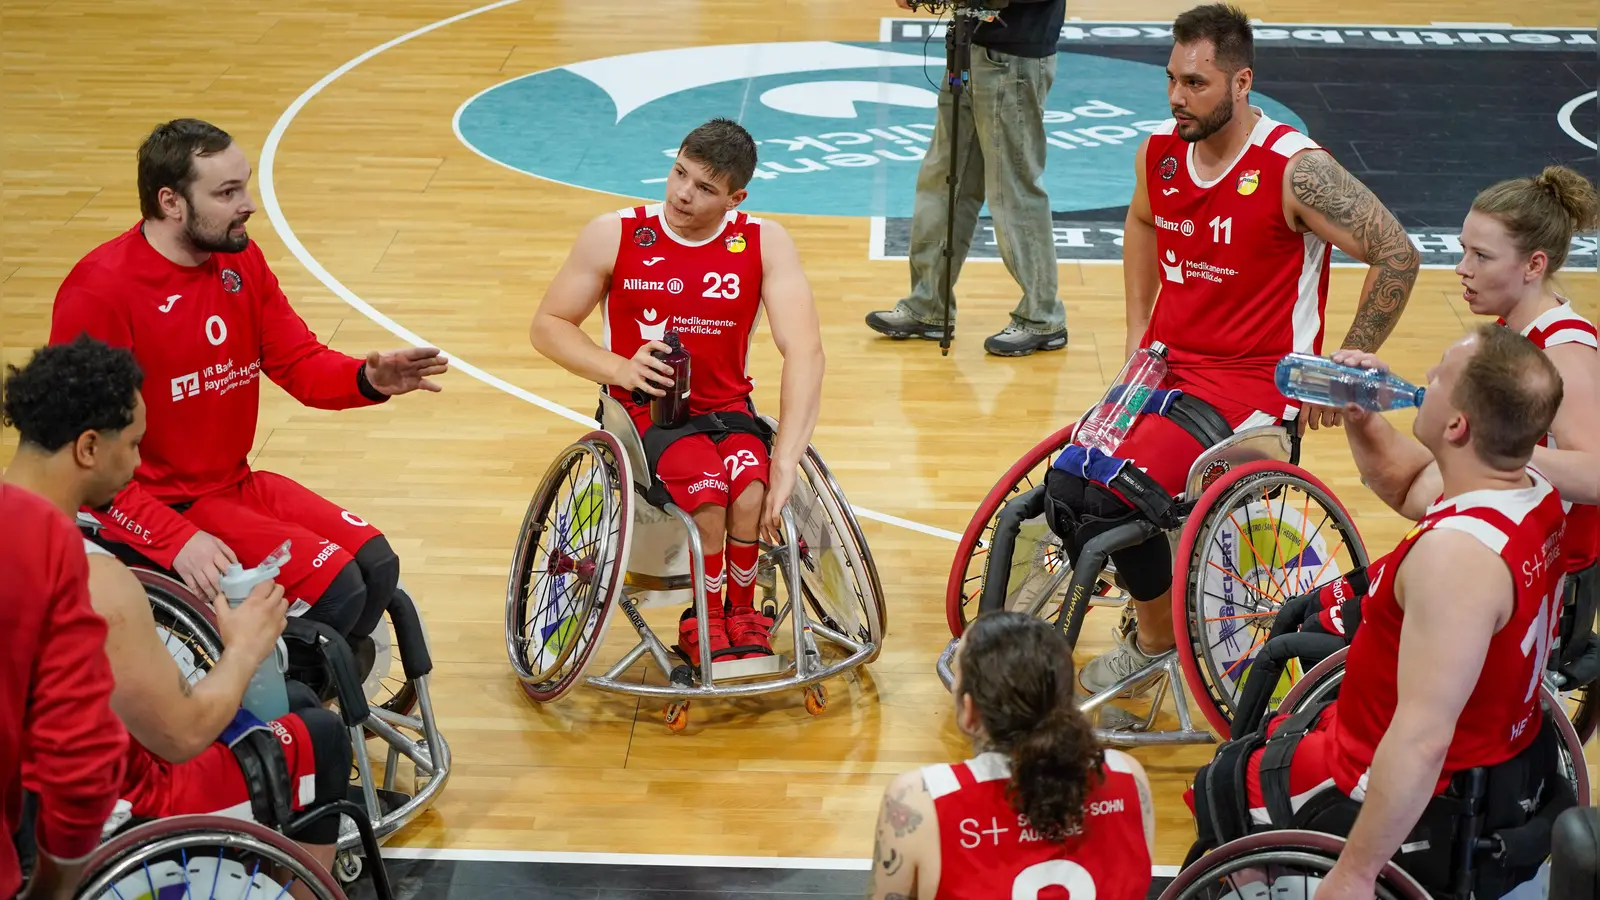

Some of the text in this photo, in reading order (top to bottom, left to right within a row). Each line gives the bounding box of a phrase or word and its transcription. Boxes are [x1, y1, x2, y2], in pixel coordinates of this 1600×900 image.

[1208, 216, 1233, 244] 11
[623, 278, 664, 291] Allianz
[702, 272, 740, 299] 23
[205, 315, 228, 346] 0
[672, 315, 737, 327] Medikamente-
[672, 325, 722, 335] per-Klick.de
[203, 358, 234, 378] VR Bak
[723, 449, 760, 481] 23
[107, 505, 152, 544] MIEDE
[1222, 530, 1236, 618] BECHERT
[621, 600, 645, 634] INVADER
